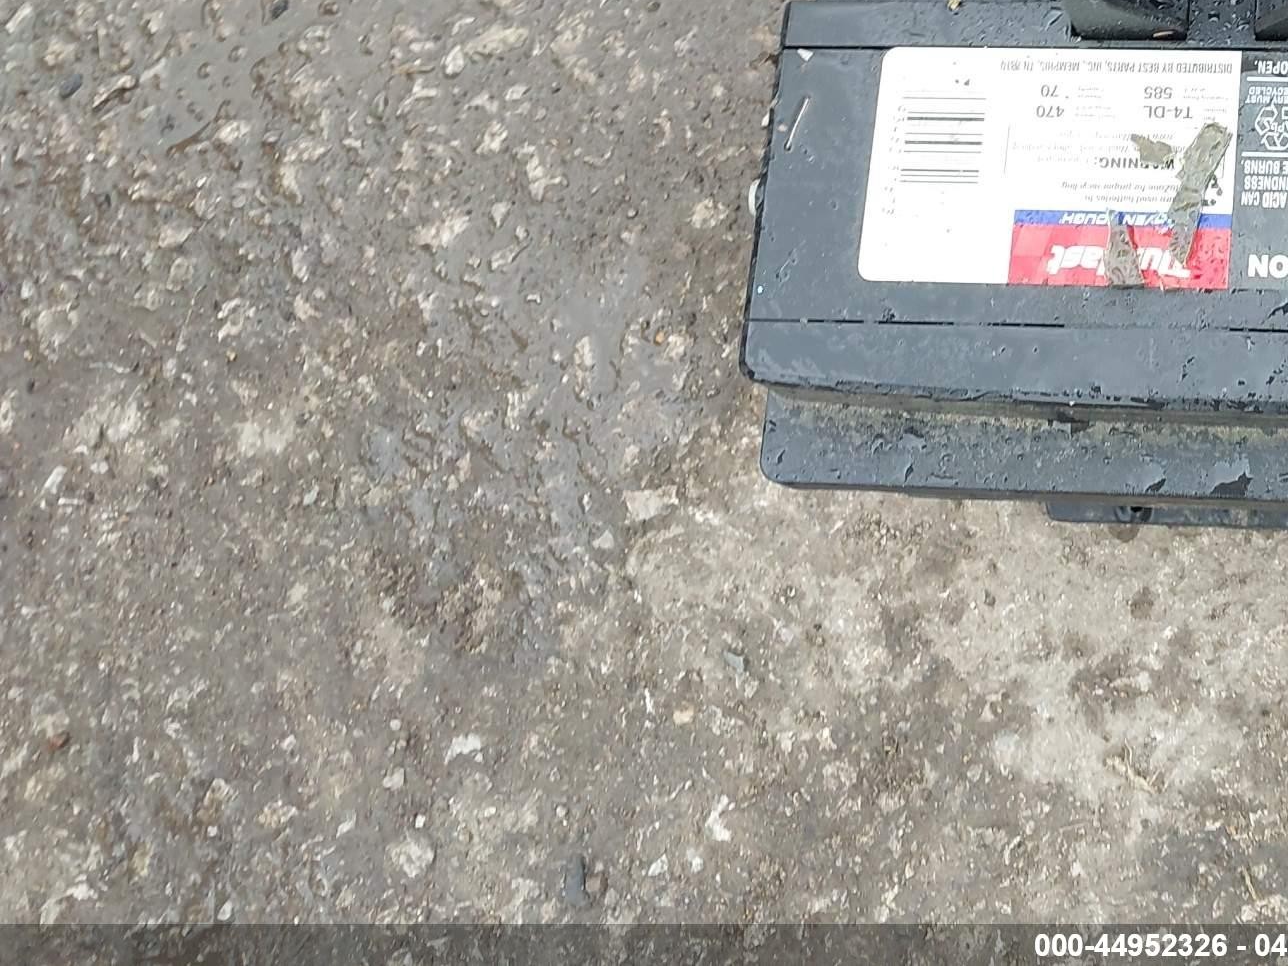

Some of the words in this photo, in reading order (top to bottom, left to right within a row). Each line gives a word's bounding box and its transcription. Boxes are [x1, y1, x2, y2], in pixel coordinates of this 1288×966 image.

[1105, 60, 1135, 73] PARTS,
[1138, 62, 1159, 73] BEST
[1162, 62, 1173, 74] BY
[1176, 63, 1232, 74] DISTRIBUTED
[1040, 85, 1059, 98] 70
[1143, 86, 1173, 100] 585
[1245, 95, 1270, 103] MUST
[1036, 105, 1064, 118] 470
[1143, 106, 1192, 119] T4-DL
[1241, 191, 1260, 205] CAN
[1262, 192, 1287, 208] ACID
